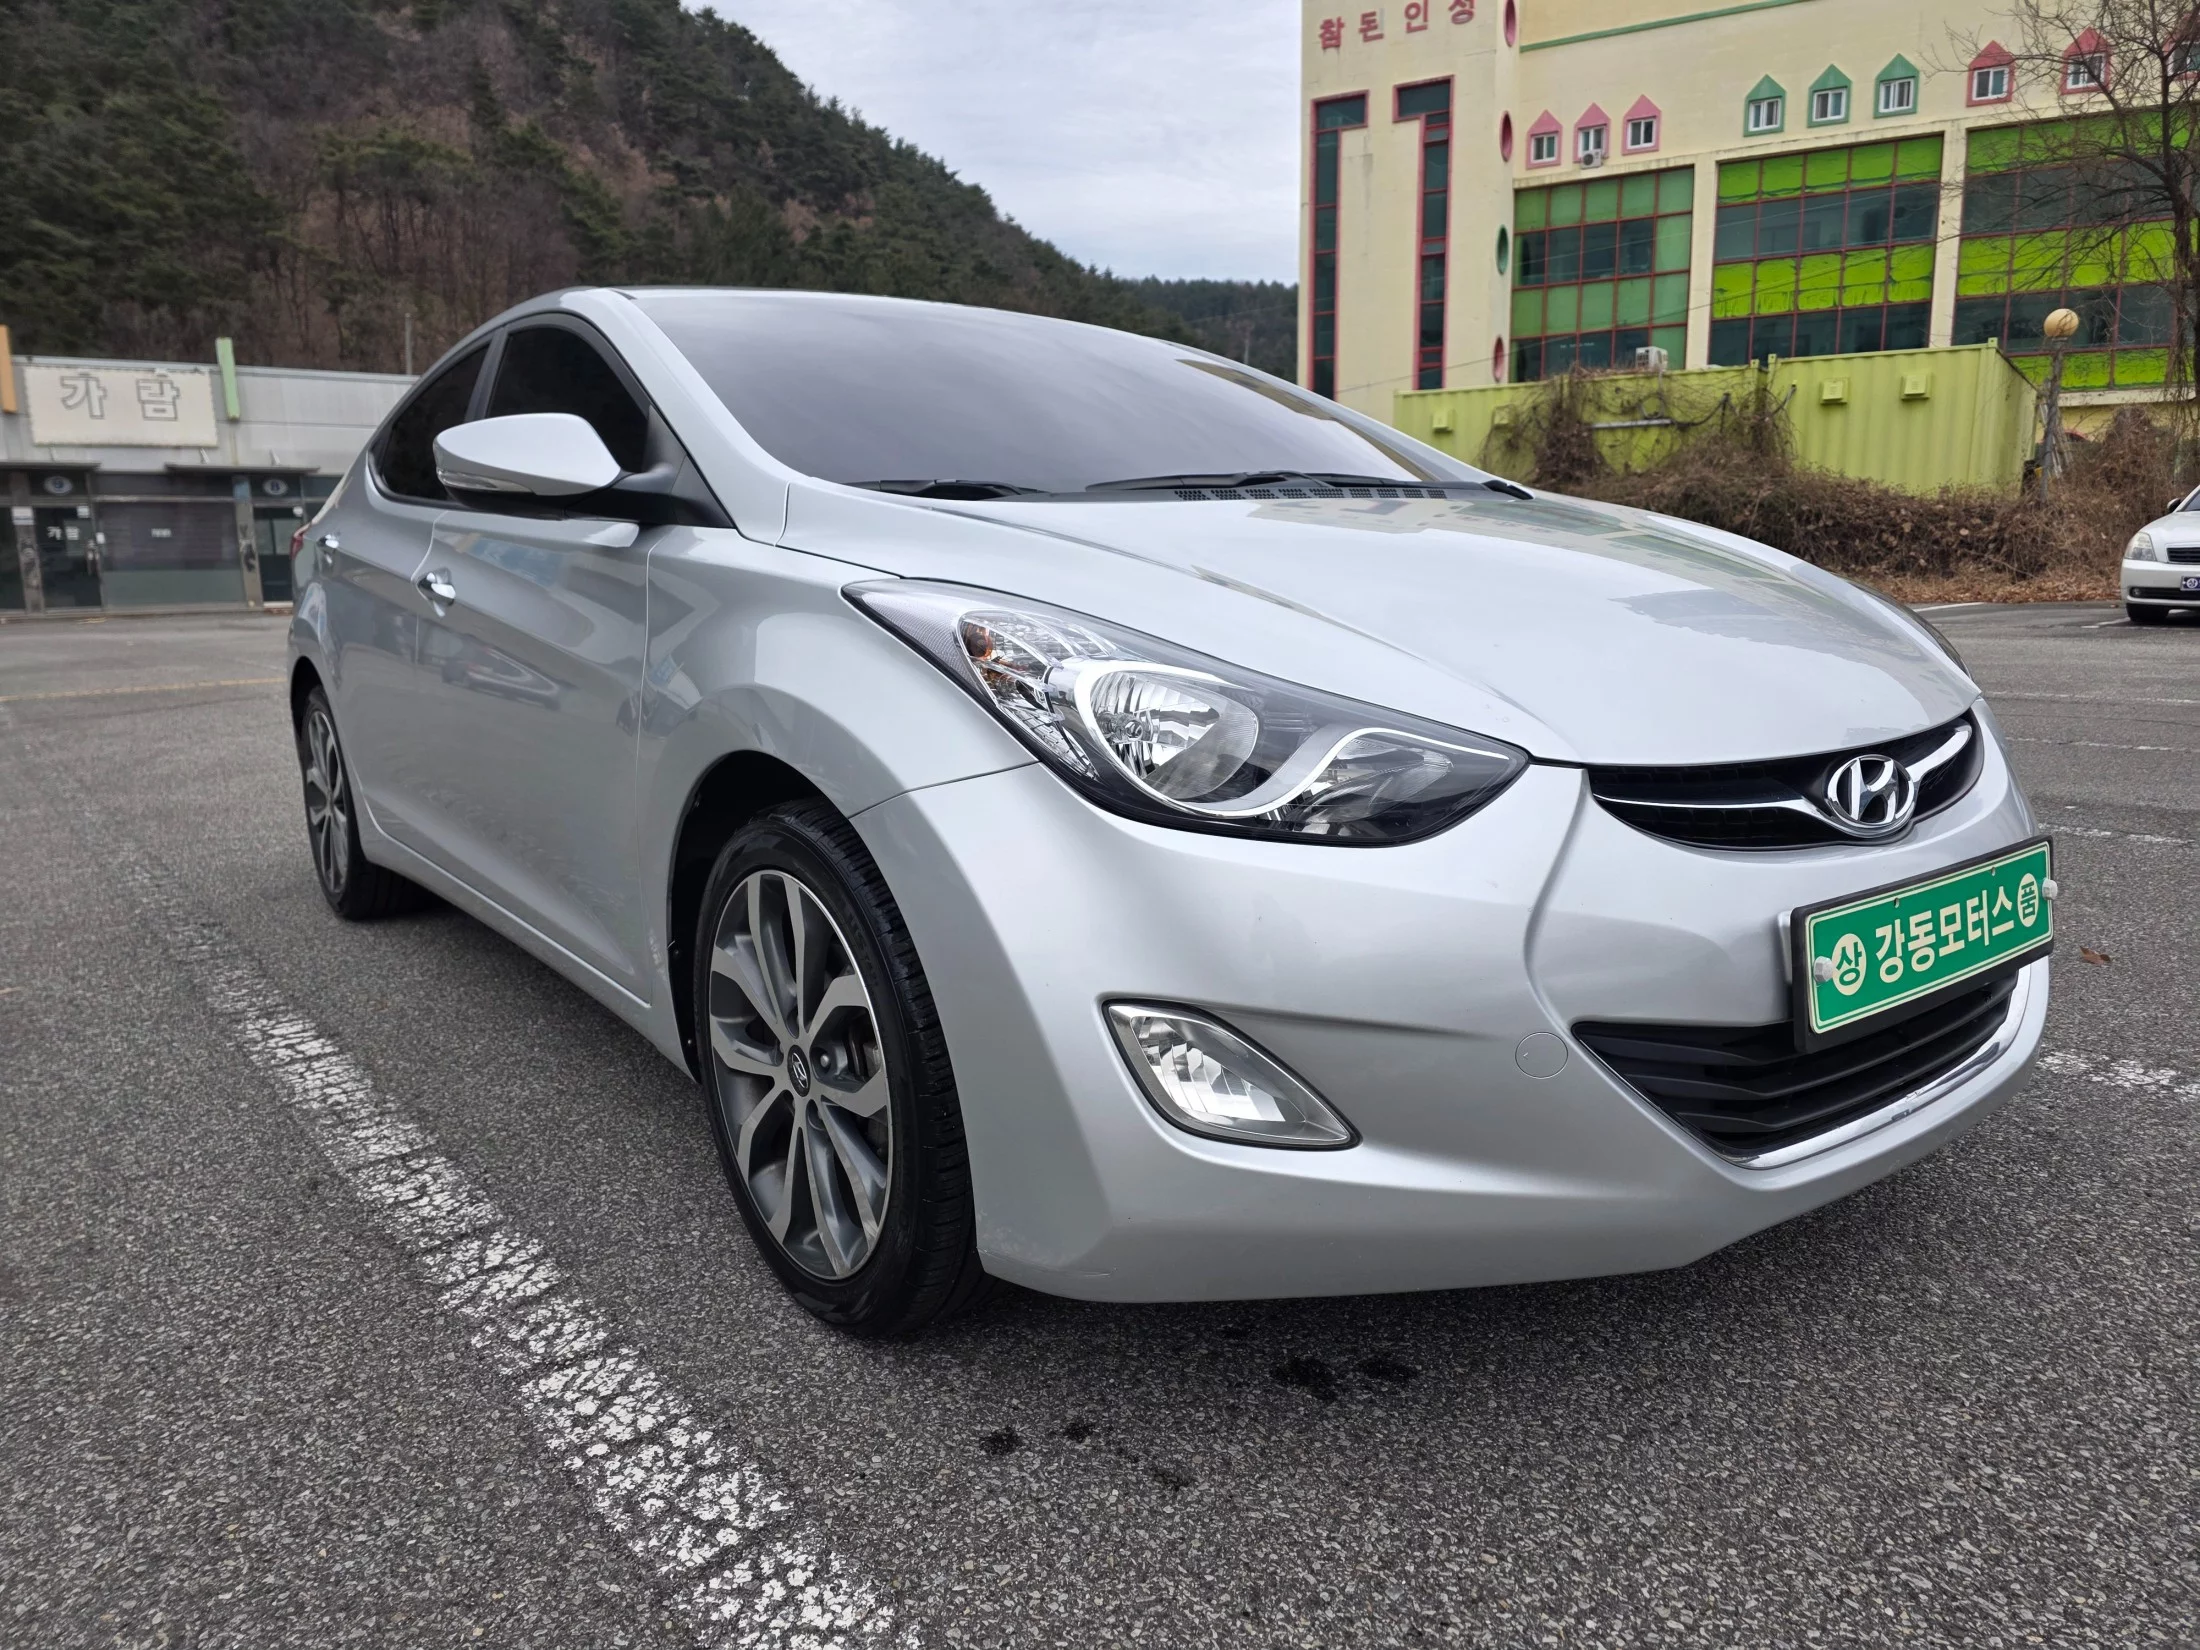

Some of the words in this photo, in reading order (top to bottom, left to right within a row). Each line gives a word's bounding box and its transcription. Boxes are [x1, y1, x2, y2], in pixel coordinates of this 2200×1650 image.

[1834, 938, 1864, 990] 상
[1875, 886, 2015, 983] 강동모터스
[2019, 877, 2037, 924] 품
